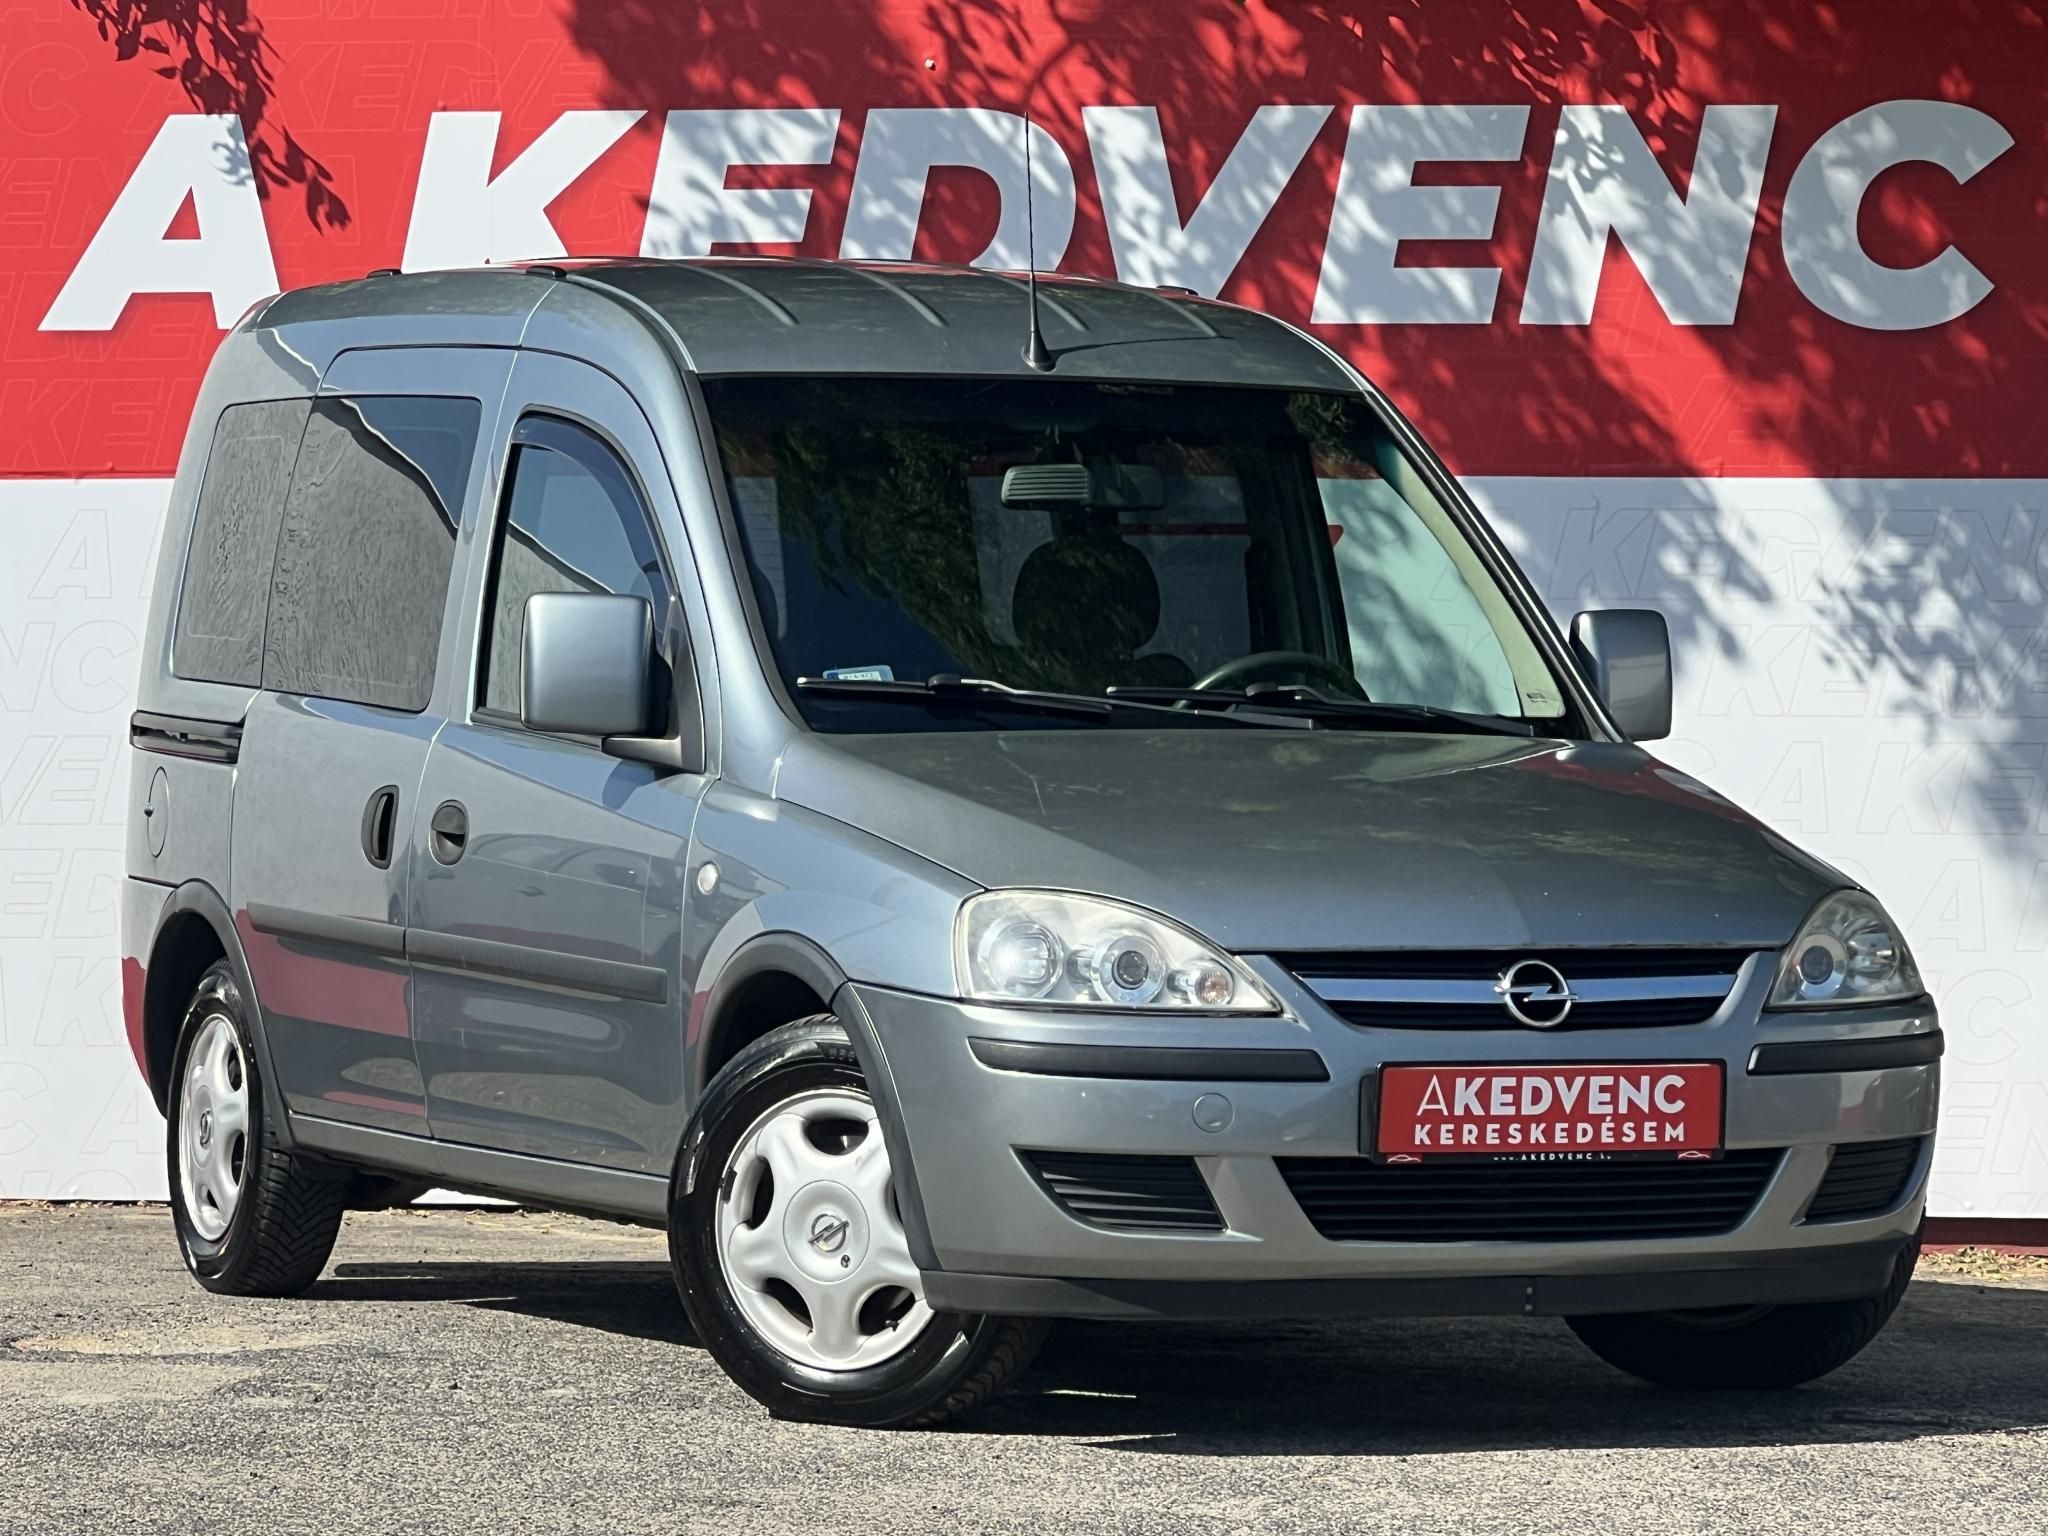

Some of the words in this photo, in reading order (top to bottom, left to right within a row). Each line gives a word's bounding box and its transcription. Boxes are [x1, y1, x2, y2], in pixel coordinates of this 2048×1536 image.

[37, 114, 283, 332] A
[400, 100, 2015, 331] KEDVENC
[1414, 1117, 1685, 1146] KERESKEDÉSEM
